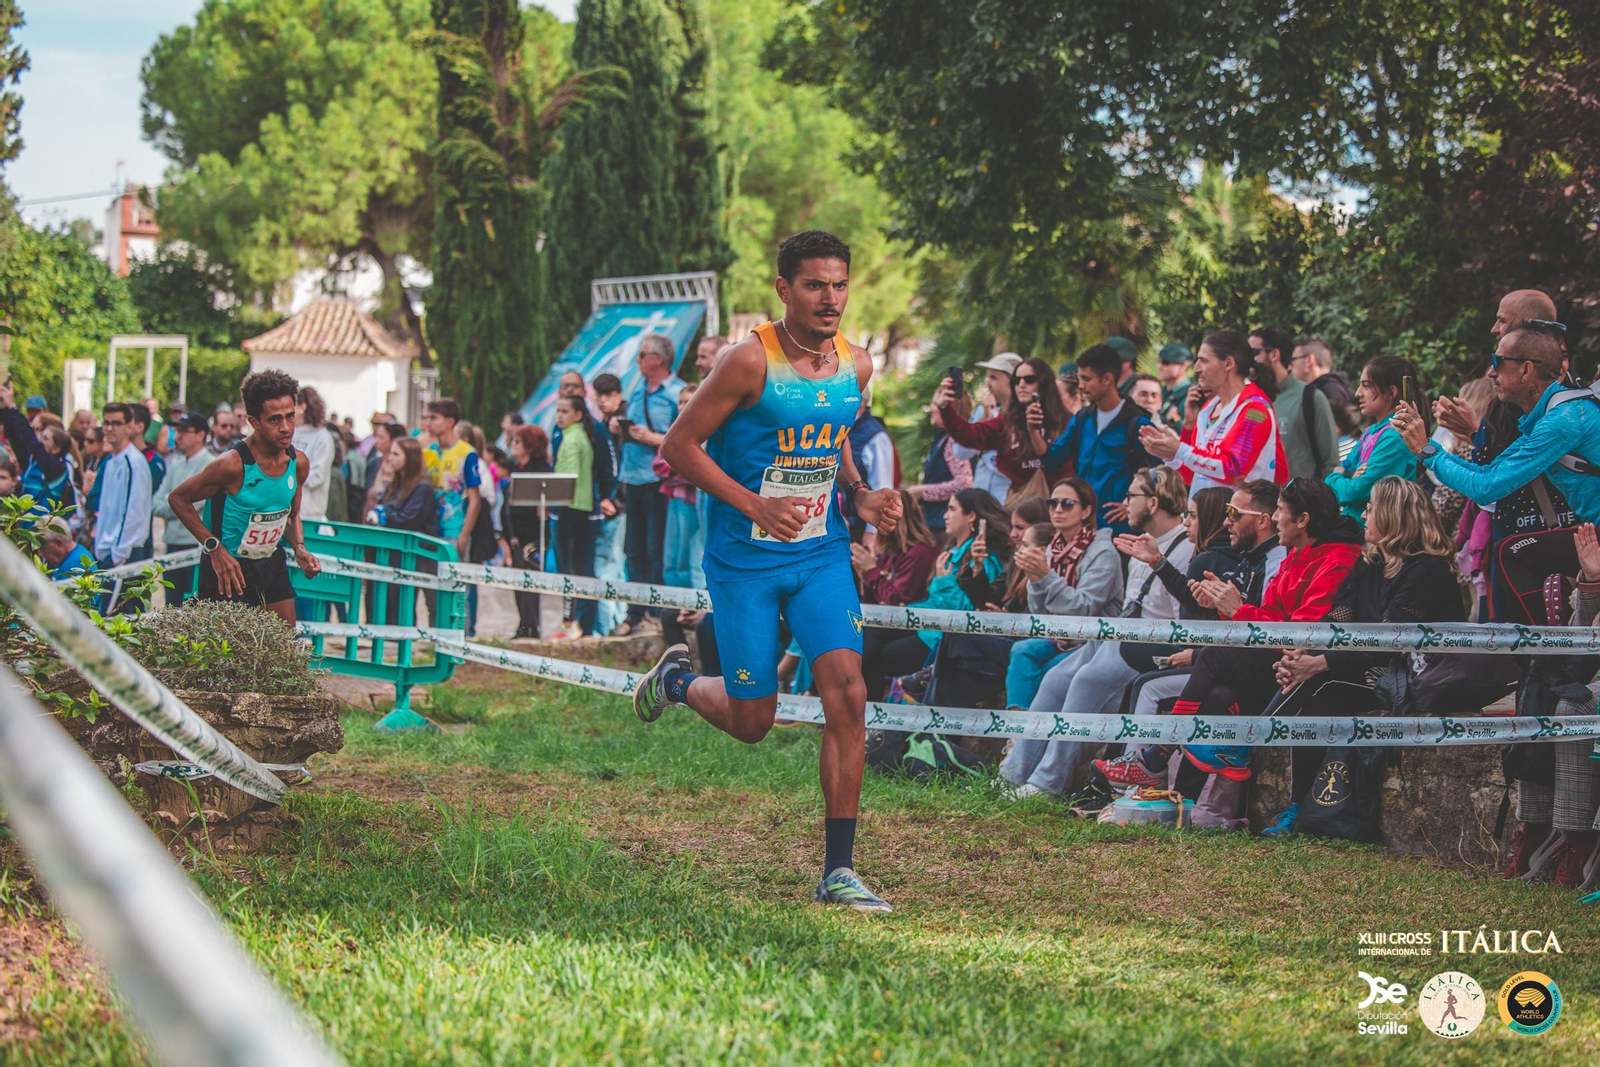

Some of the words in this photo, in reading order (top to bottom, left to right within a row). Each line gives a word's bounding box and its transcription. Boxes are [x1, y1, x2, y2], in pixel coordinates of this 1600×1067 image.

[1516, 515, 1536, 528] OFF
[1539, 511, 1575, 525] WITE
[1116, 631, 1139, 641] Sevilla
[1189, 633, 1214, 644] Sevilla
[1268, 636, 1294, 647] Sevilla
[1352, 637, 1380, 648] Sevilla
[1443, 637, 1473, 648] Sevilla
[1541, 637, 1574, 648] Sevilla
[1138, 728, 1161, 738] Sevilla
[1211, 729, 1236, 740] Sevilla
[1290, 730, 1317, 741] Sevilla
[1375, 730, 1404, 740] Sevilla
[1466, 729, 1497, 739] Sevilla
[1561, 727, 1594, 736] Sevilla
